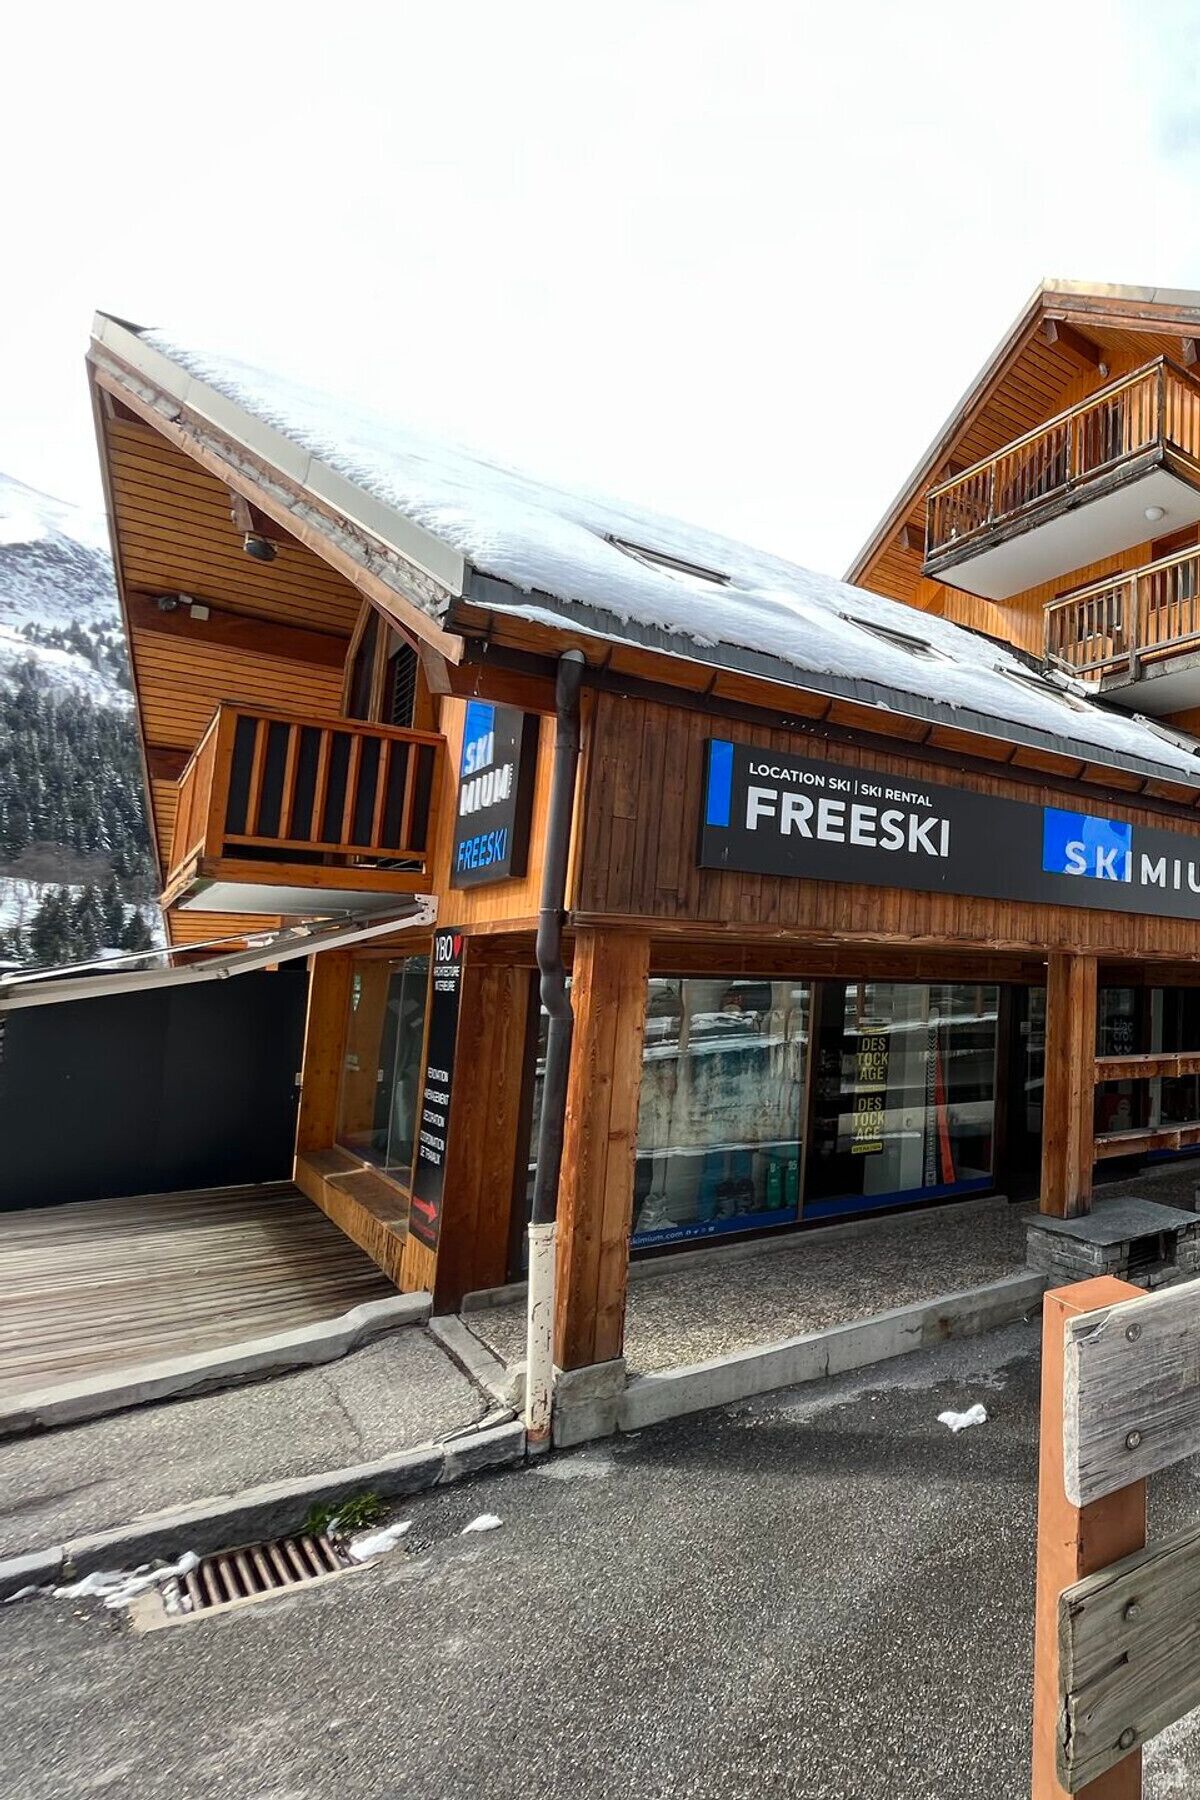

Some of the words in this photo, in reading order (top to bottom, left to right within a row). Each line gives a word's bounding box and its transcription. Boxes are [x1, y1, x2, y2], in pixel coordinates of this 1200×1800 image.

[465, 731, 494, 775] SKI
[459, 764, 509, 816] MIUM
[749, 762, 825, 788] LOCATION
[829, 777, 851, 792] SKI
[861, 783, 882, 797] SKI
[885, 788, 933, 808] RENTAL
[746, 786, 950, 858] FREESKI
[457, 828, 508, 872] FREESKI
[435, 935, 453, 961] YBO
[862, 1038, 886, 1051] DES
[857, 1052, 889, 1066] TOCK
[860, 1067, 884, 1081] AGE
[858, 1097, 882, 1111] DES
[853, 1111, 885, 1127] TOCK
[857, 1127, 881, 1140] AGE
